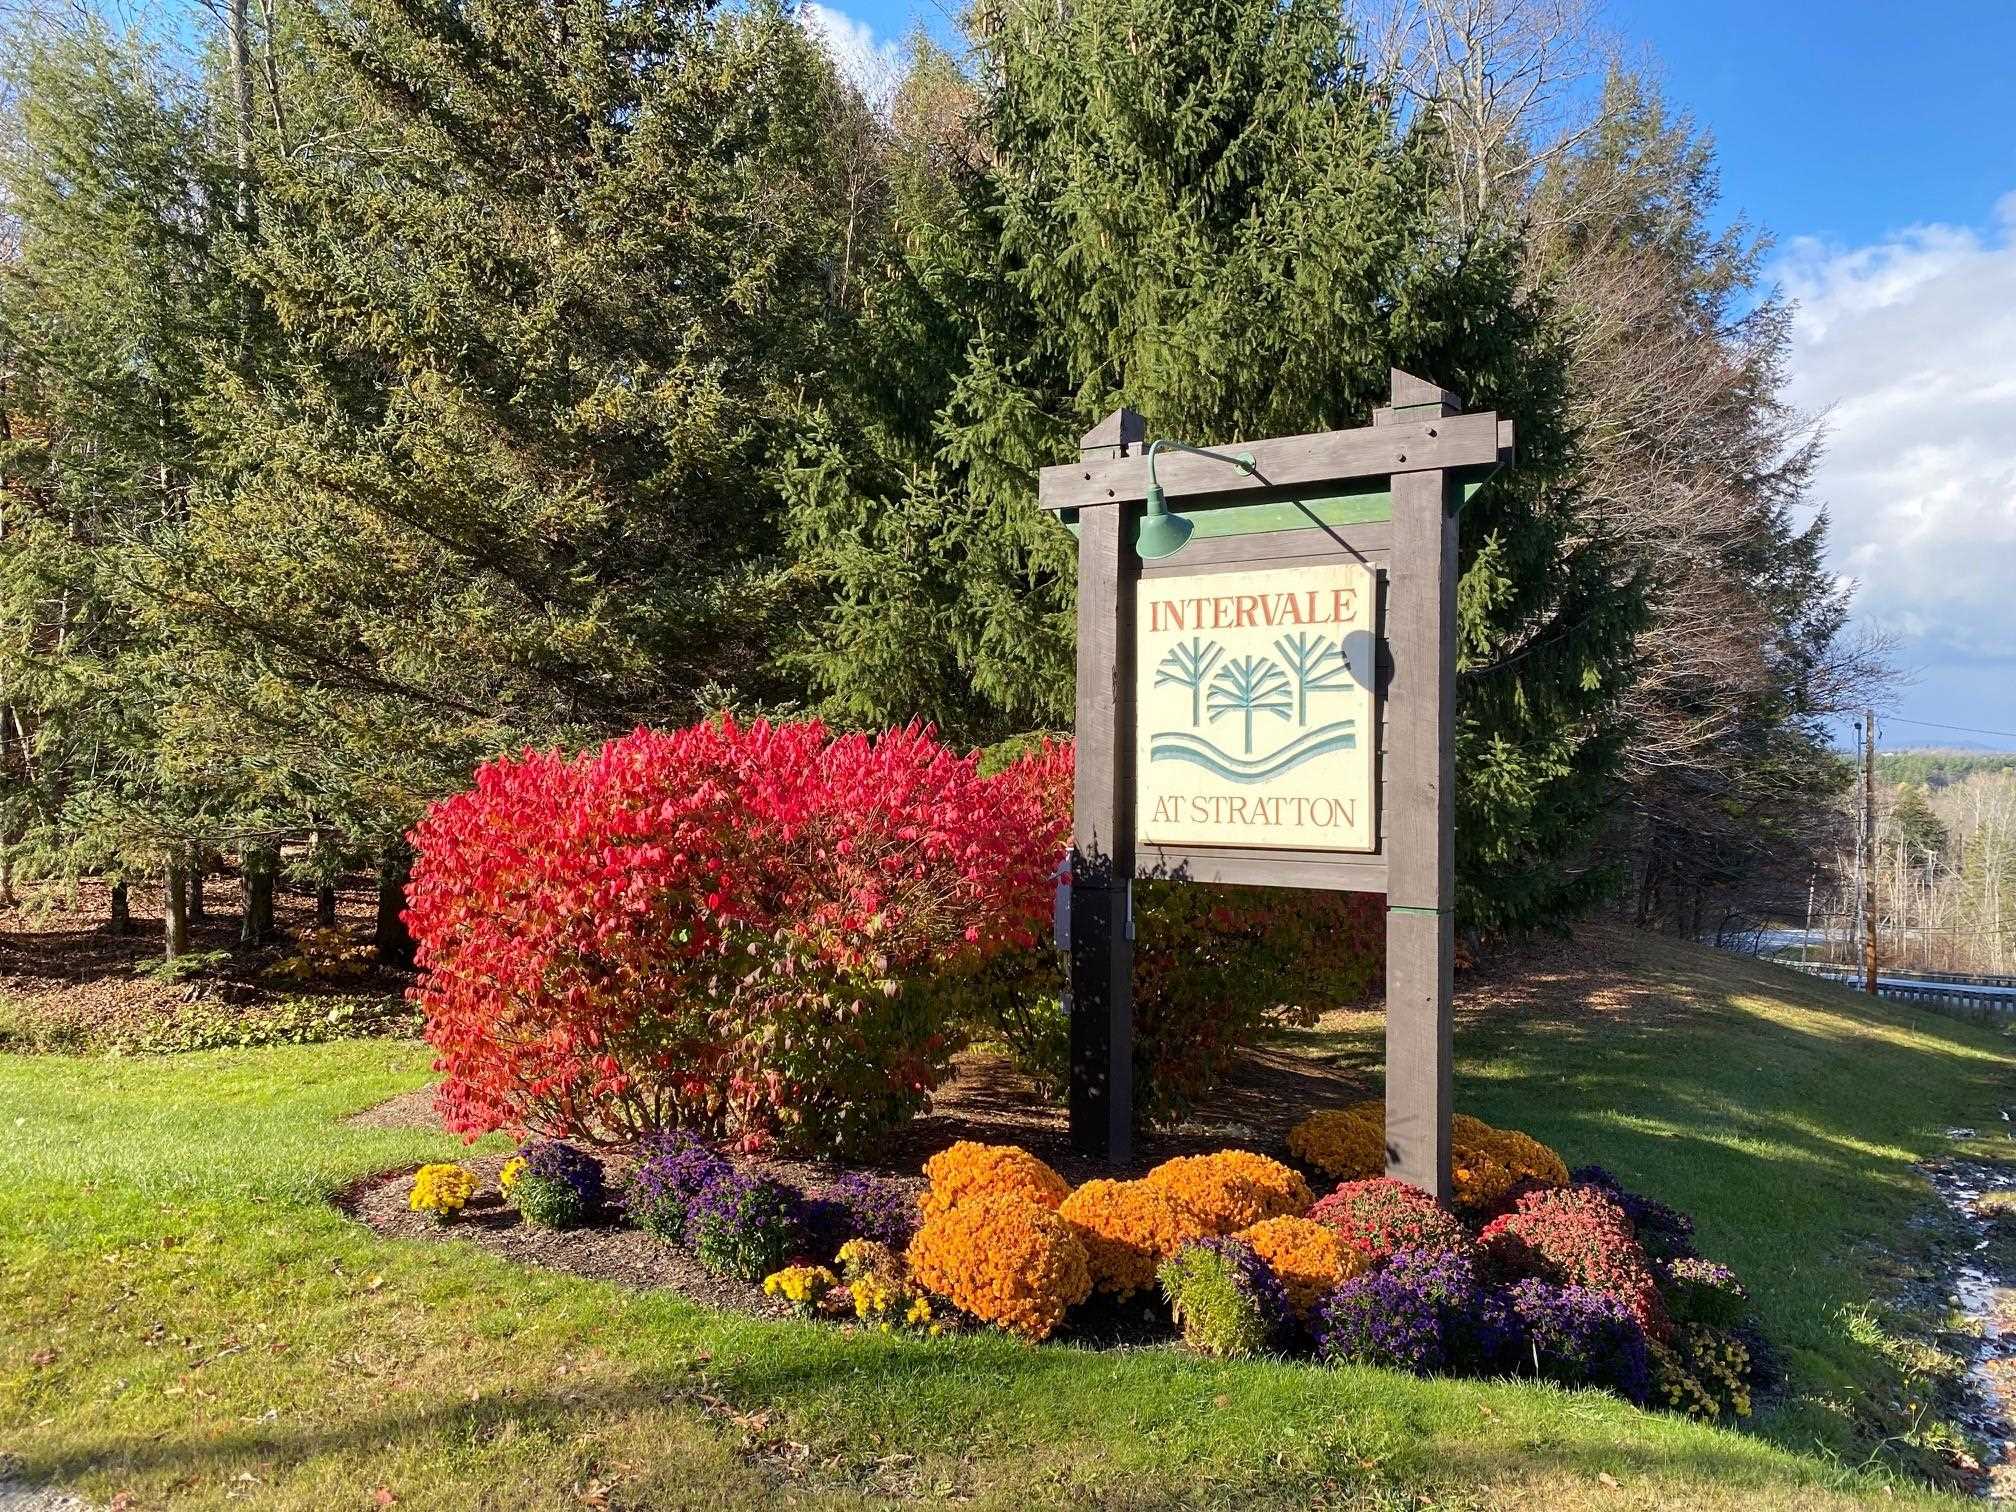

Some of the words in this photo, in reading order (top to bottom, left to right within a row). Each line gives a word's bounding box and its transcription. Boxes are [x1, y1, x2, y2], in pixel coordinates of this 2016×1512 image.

[1148, 588, 1358, 632] INTERVALE
[1152, 795, 1184, 823] AT
[1190, 795, 1356, 827] STRATTON
